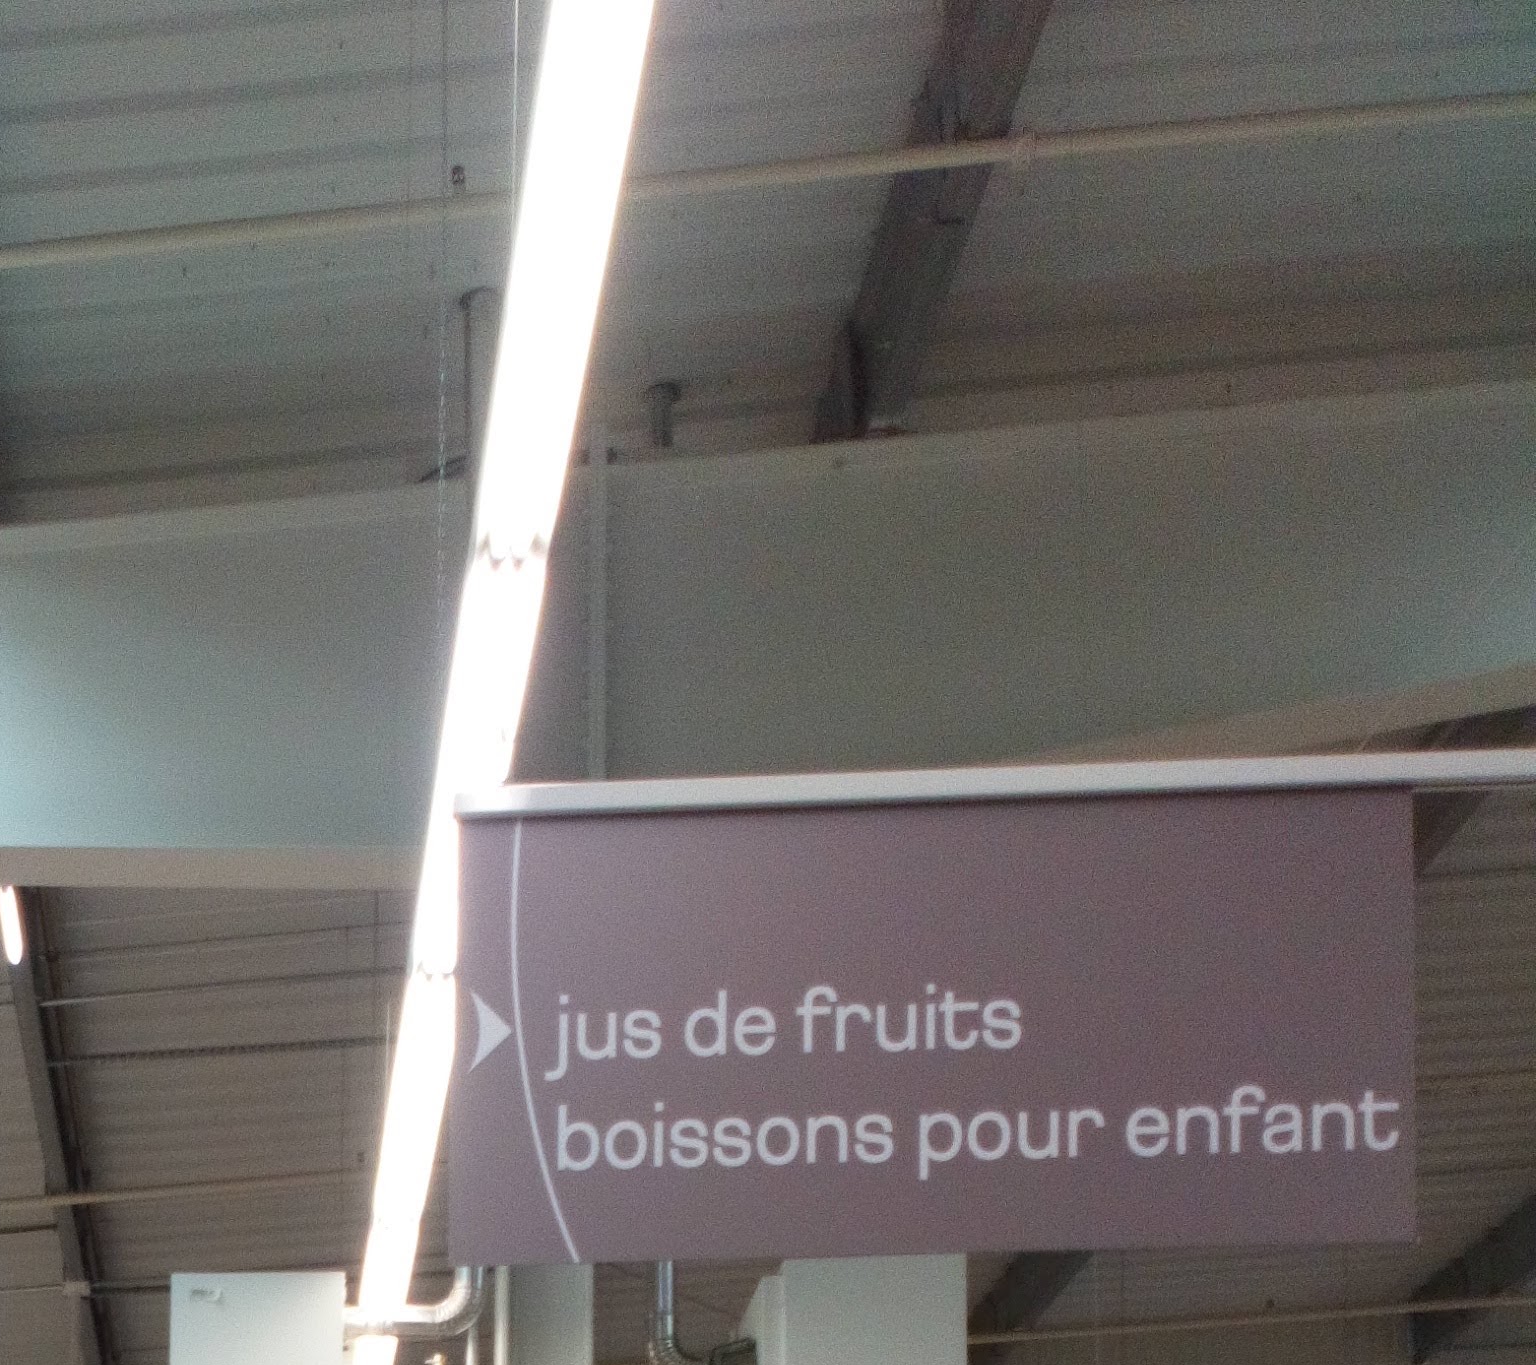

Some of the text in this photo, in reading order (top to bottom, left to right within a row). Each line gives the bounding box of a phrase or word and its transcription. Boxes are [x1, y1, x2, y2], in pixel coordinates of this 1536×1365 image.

[544, 984, 1024, 1082] jus de fruits
[556, 1085, 1402, 1180] boissons pour enfant
